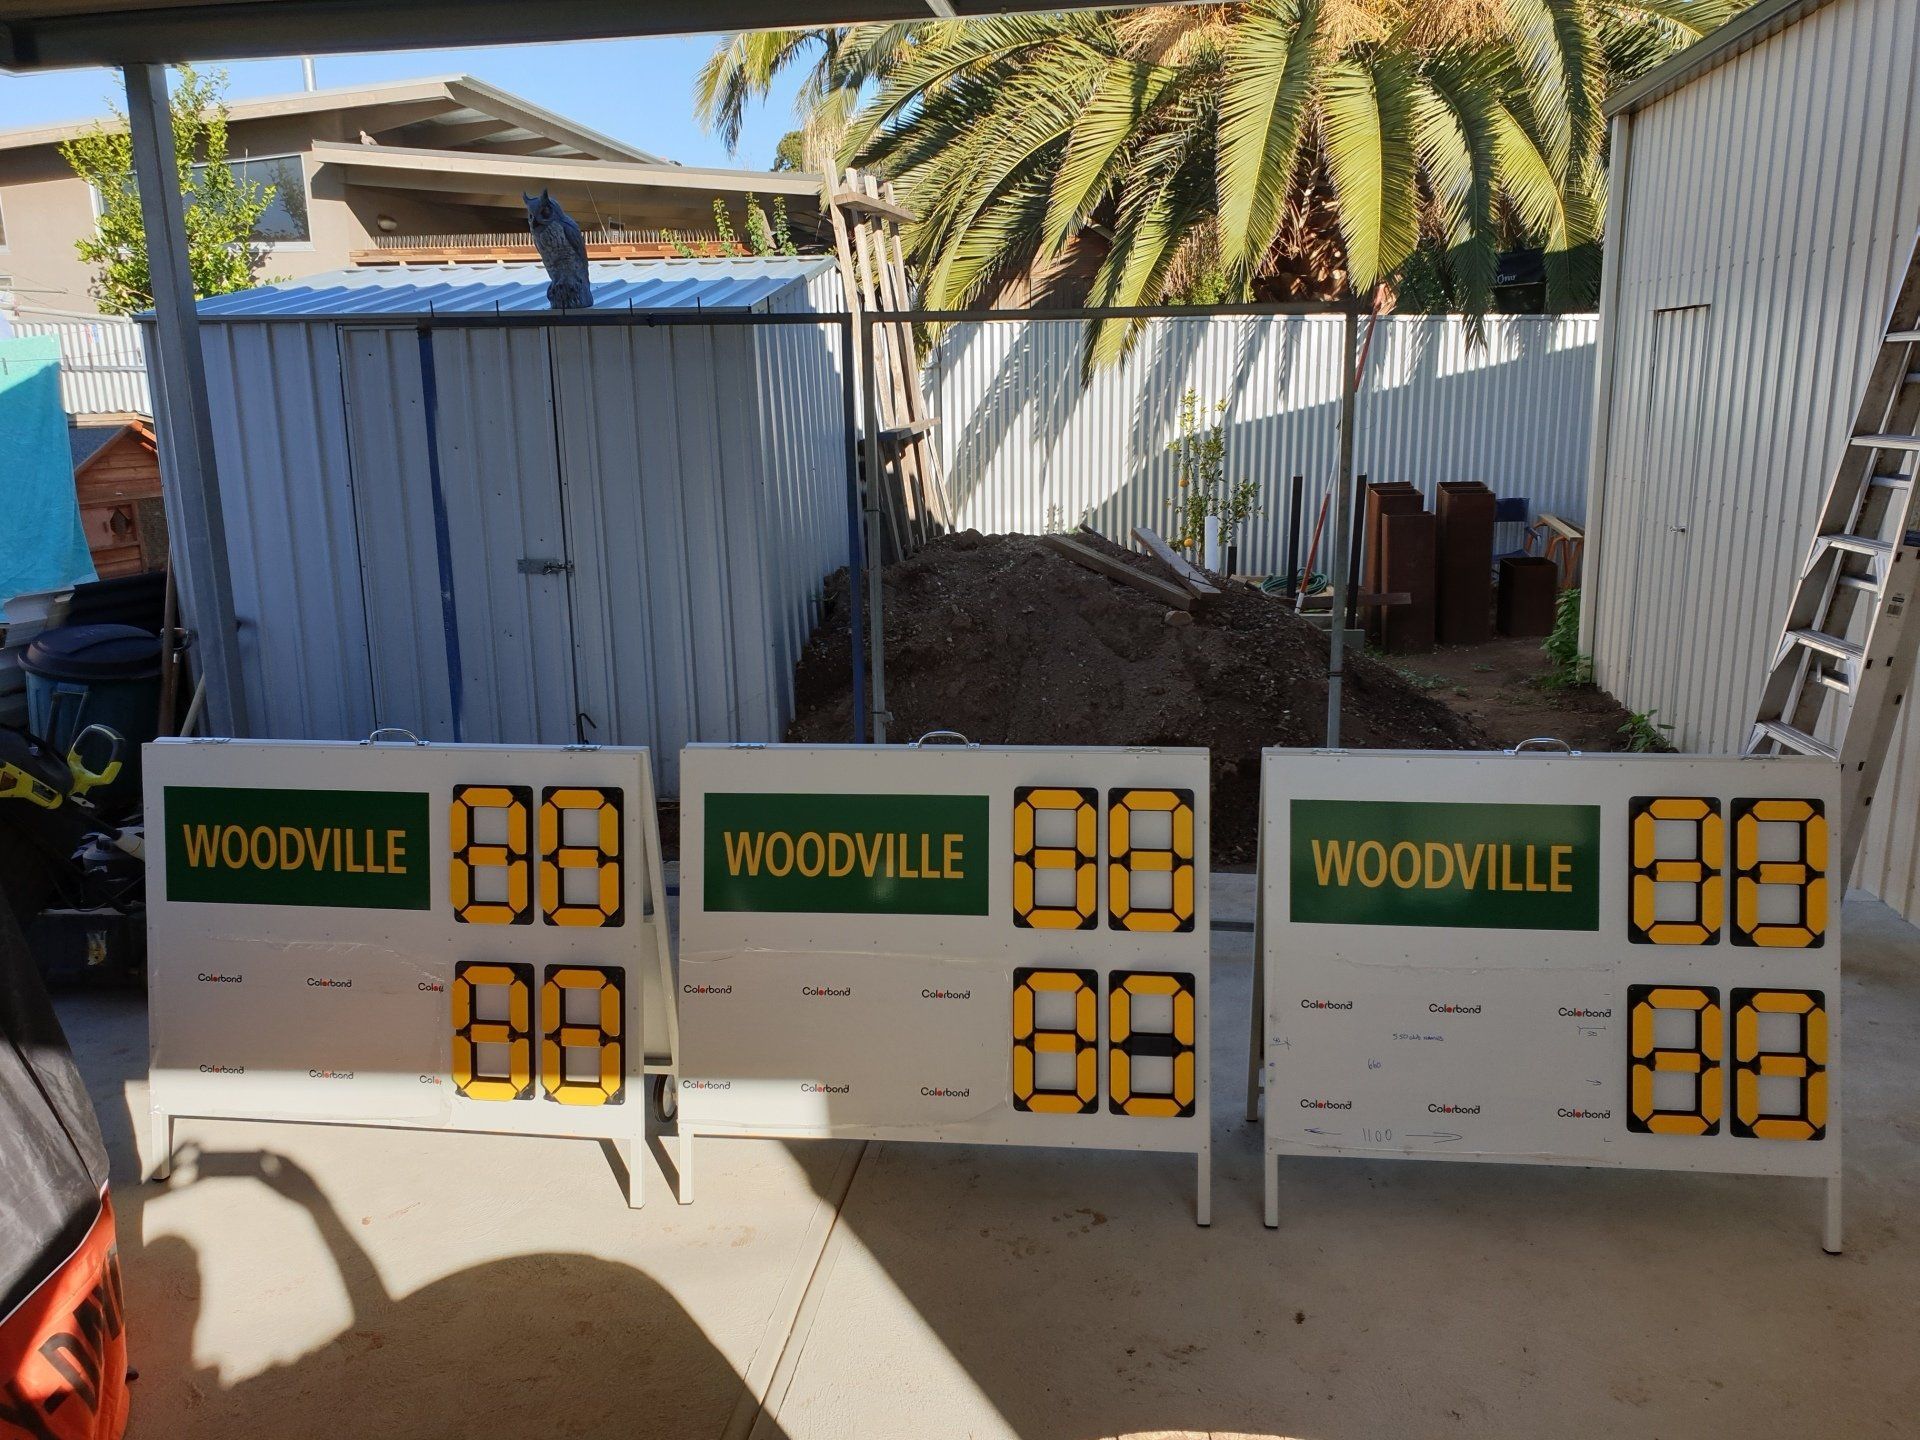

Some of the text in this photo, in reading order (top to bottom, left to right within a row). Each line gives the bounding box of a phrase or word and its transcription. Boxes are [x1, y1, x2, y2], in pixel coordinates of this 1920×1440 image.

[182, 823, 407, 876] WOODVILLE
[724, 830, 965, 881] WOODVILLE
[1311, 838, 1574, 893] WOODVILLE
[197, 972, 243, 984] Colorbond
[306, 977, 353, 989] Colorbond
[683, 984, 733, 995] Colorbond
[802, 986, 851, 998] Colorbond
[921, 988, 971, 1000] Colorbond
[1300, 999, 1353, 1011] Colorbond
[1428, 1002, 1482, 1015] Colorbond
[1557, 1006, 1612, 1019] Colorbond
[199, 1064, 245, 1076] Colorbond
[308, 1069, 354, 1081] Colorbond
[682, 1079, 731, 1091] Colorbond
[800, 1082, 850, 1095] Colorbond
[920, 1086, 970, 1098] Colorbond
[1299, 1098, 1353, 1111] Colorbond
[1427, 1102, 1481, 1115] Colorbond
[1556, 1107, 1611, 1120] Colorbond
